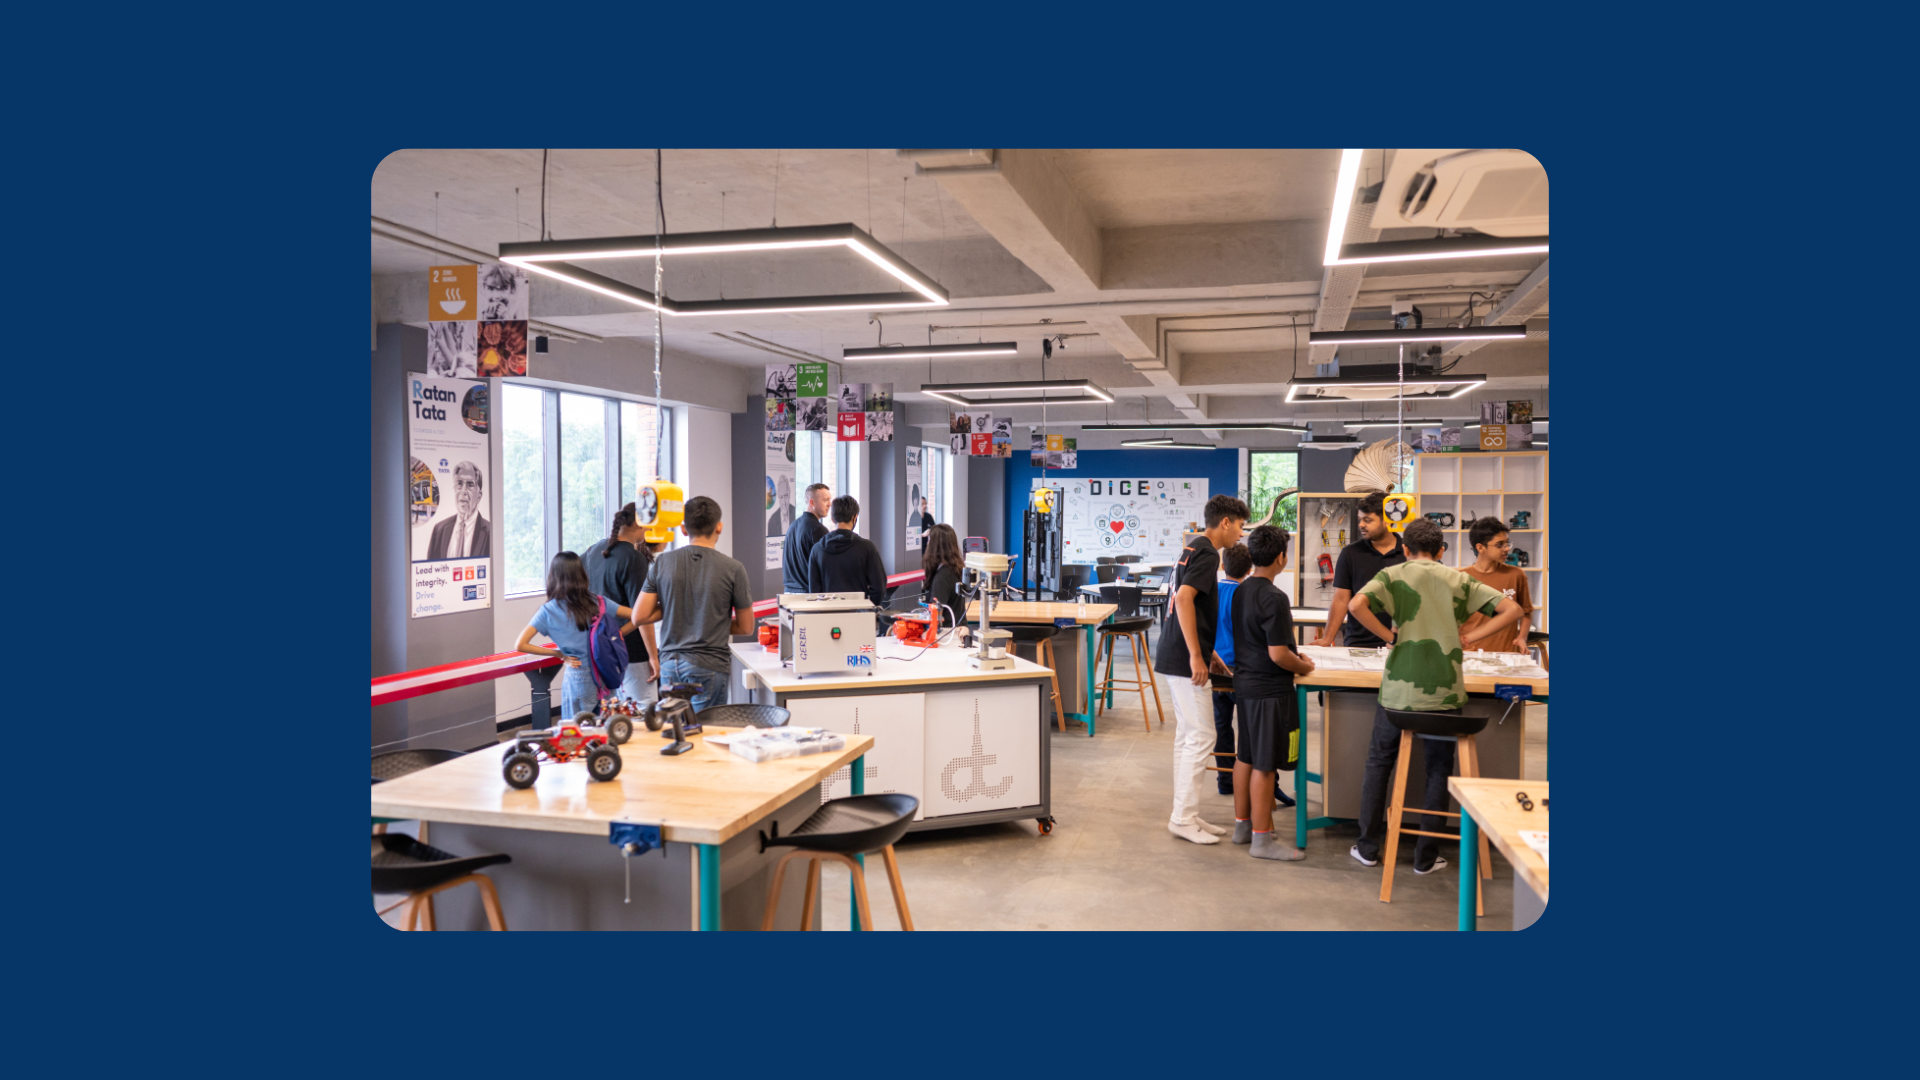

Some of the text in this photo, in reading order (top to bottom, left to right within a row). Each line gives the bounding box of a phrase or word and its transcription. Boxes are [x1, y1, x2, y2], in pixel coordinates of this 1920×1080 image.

[433, 270, 439, 283] 2
[799, 366, 804, 374] 3
[412, 380, 456, 403] Ratan
[412, 400, 446, 421] Tata
[416, 564, 449, 575] Lead with
[416, 577, 447, 588] integrity.
[416, 591, 434, 600] Drive
[416, 604, 443, 613] change.
[799, 626, 807, 660] GERBIL
